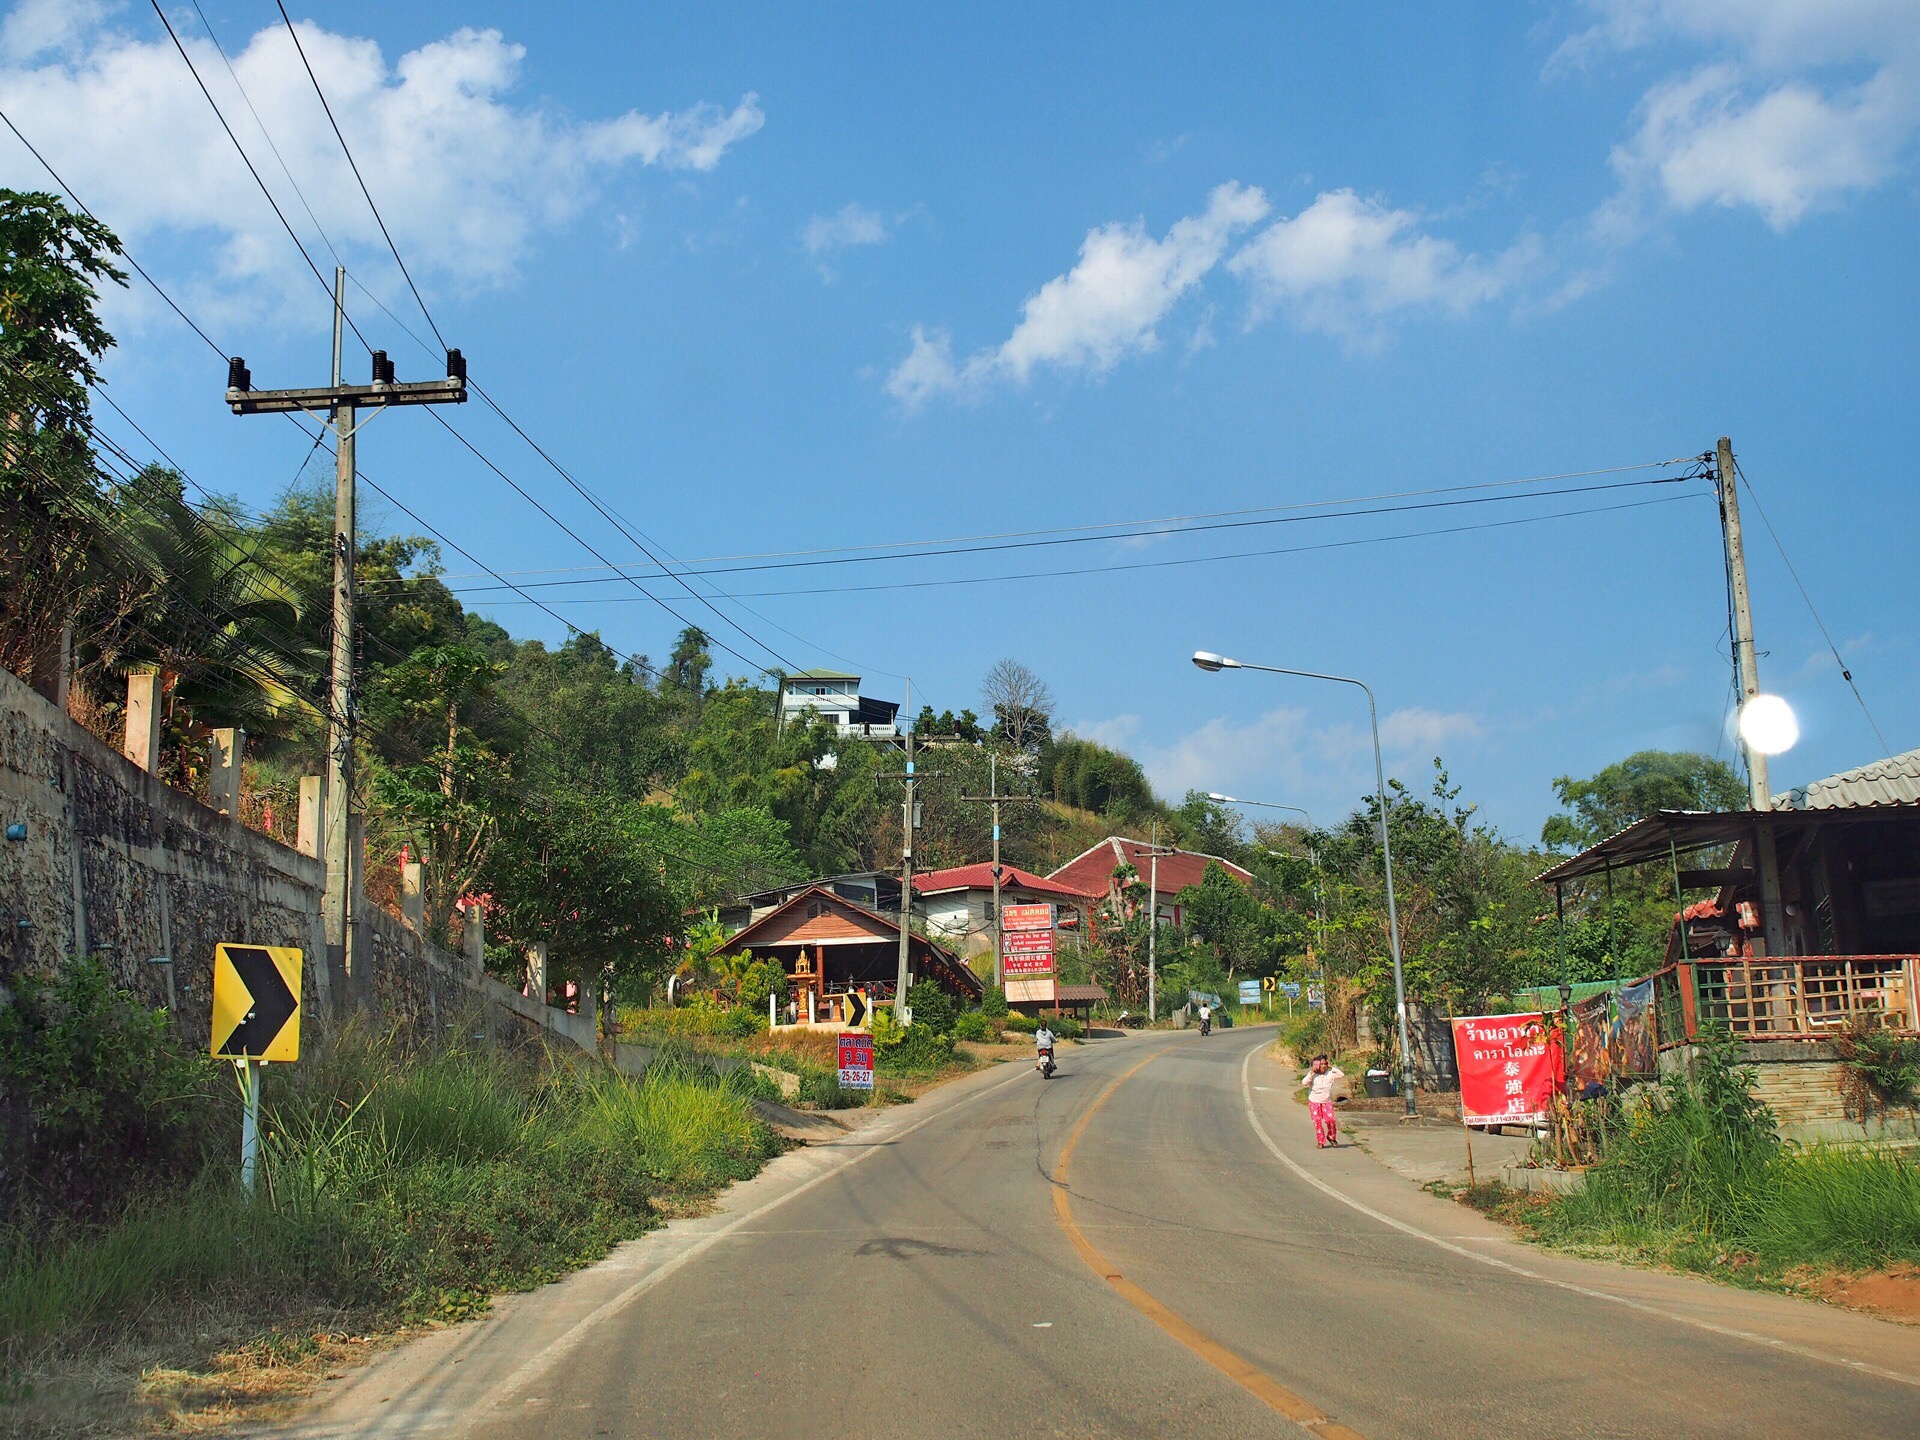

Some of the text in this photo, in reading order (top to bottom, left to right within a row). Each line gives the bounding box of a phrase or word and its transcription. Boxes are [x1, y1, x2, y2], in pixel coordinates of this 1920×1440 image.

[839, 1035, 874, 1048] ตลาดนัด
[845, 1049, 868, 1063] 3 วัน
[841, 1070, 871, 1082] 25-26-27
